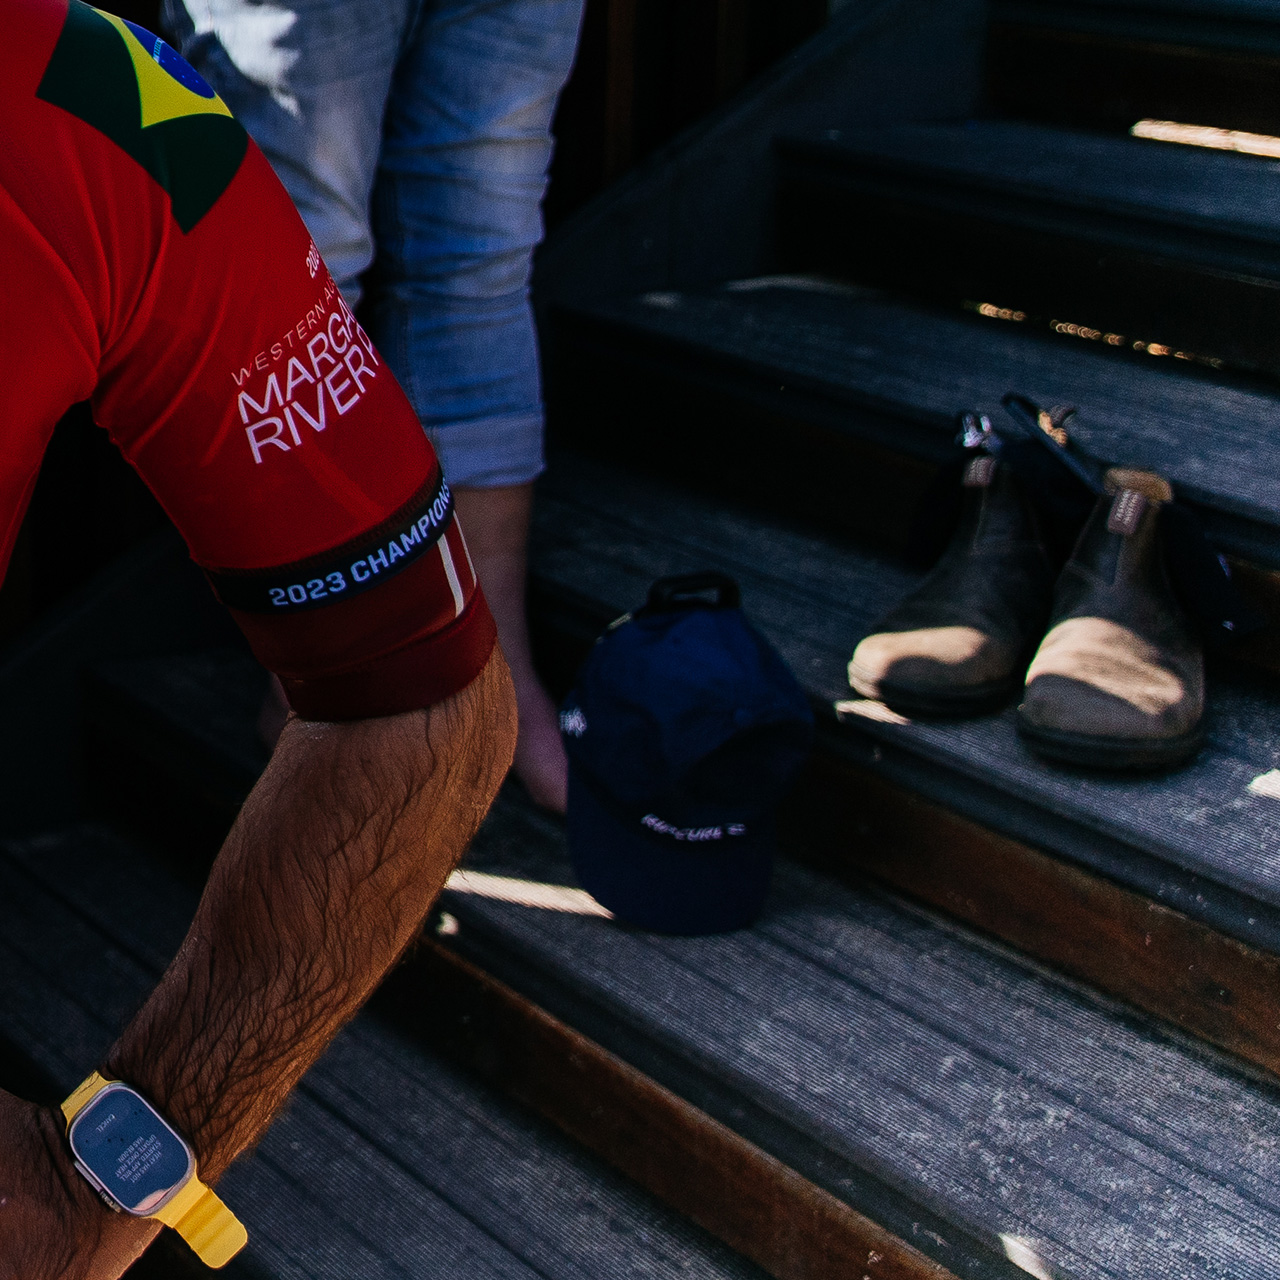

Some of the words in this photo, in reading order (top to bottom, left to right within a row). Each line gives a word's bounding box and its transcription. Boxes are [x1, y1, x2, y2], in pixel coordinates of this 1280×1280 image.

[231, 298, 326, 386] WESTERN
[237, 297, 357, 424] MARGA
[244, 344, 376, 465] RIVER
[268, 571, 347, 607] 2023
